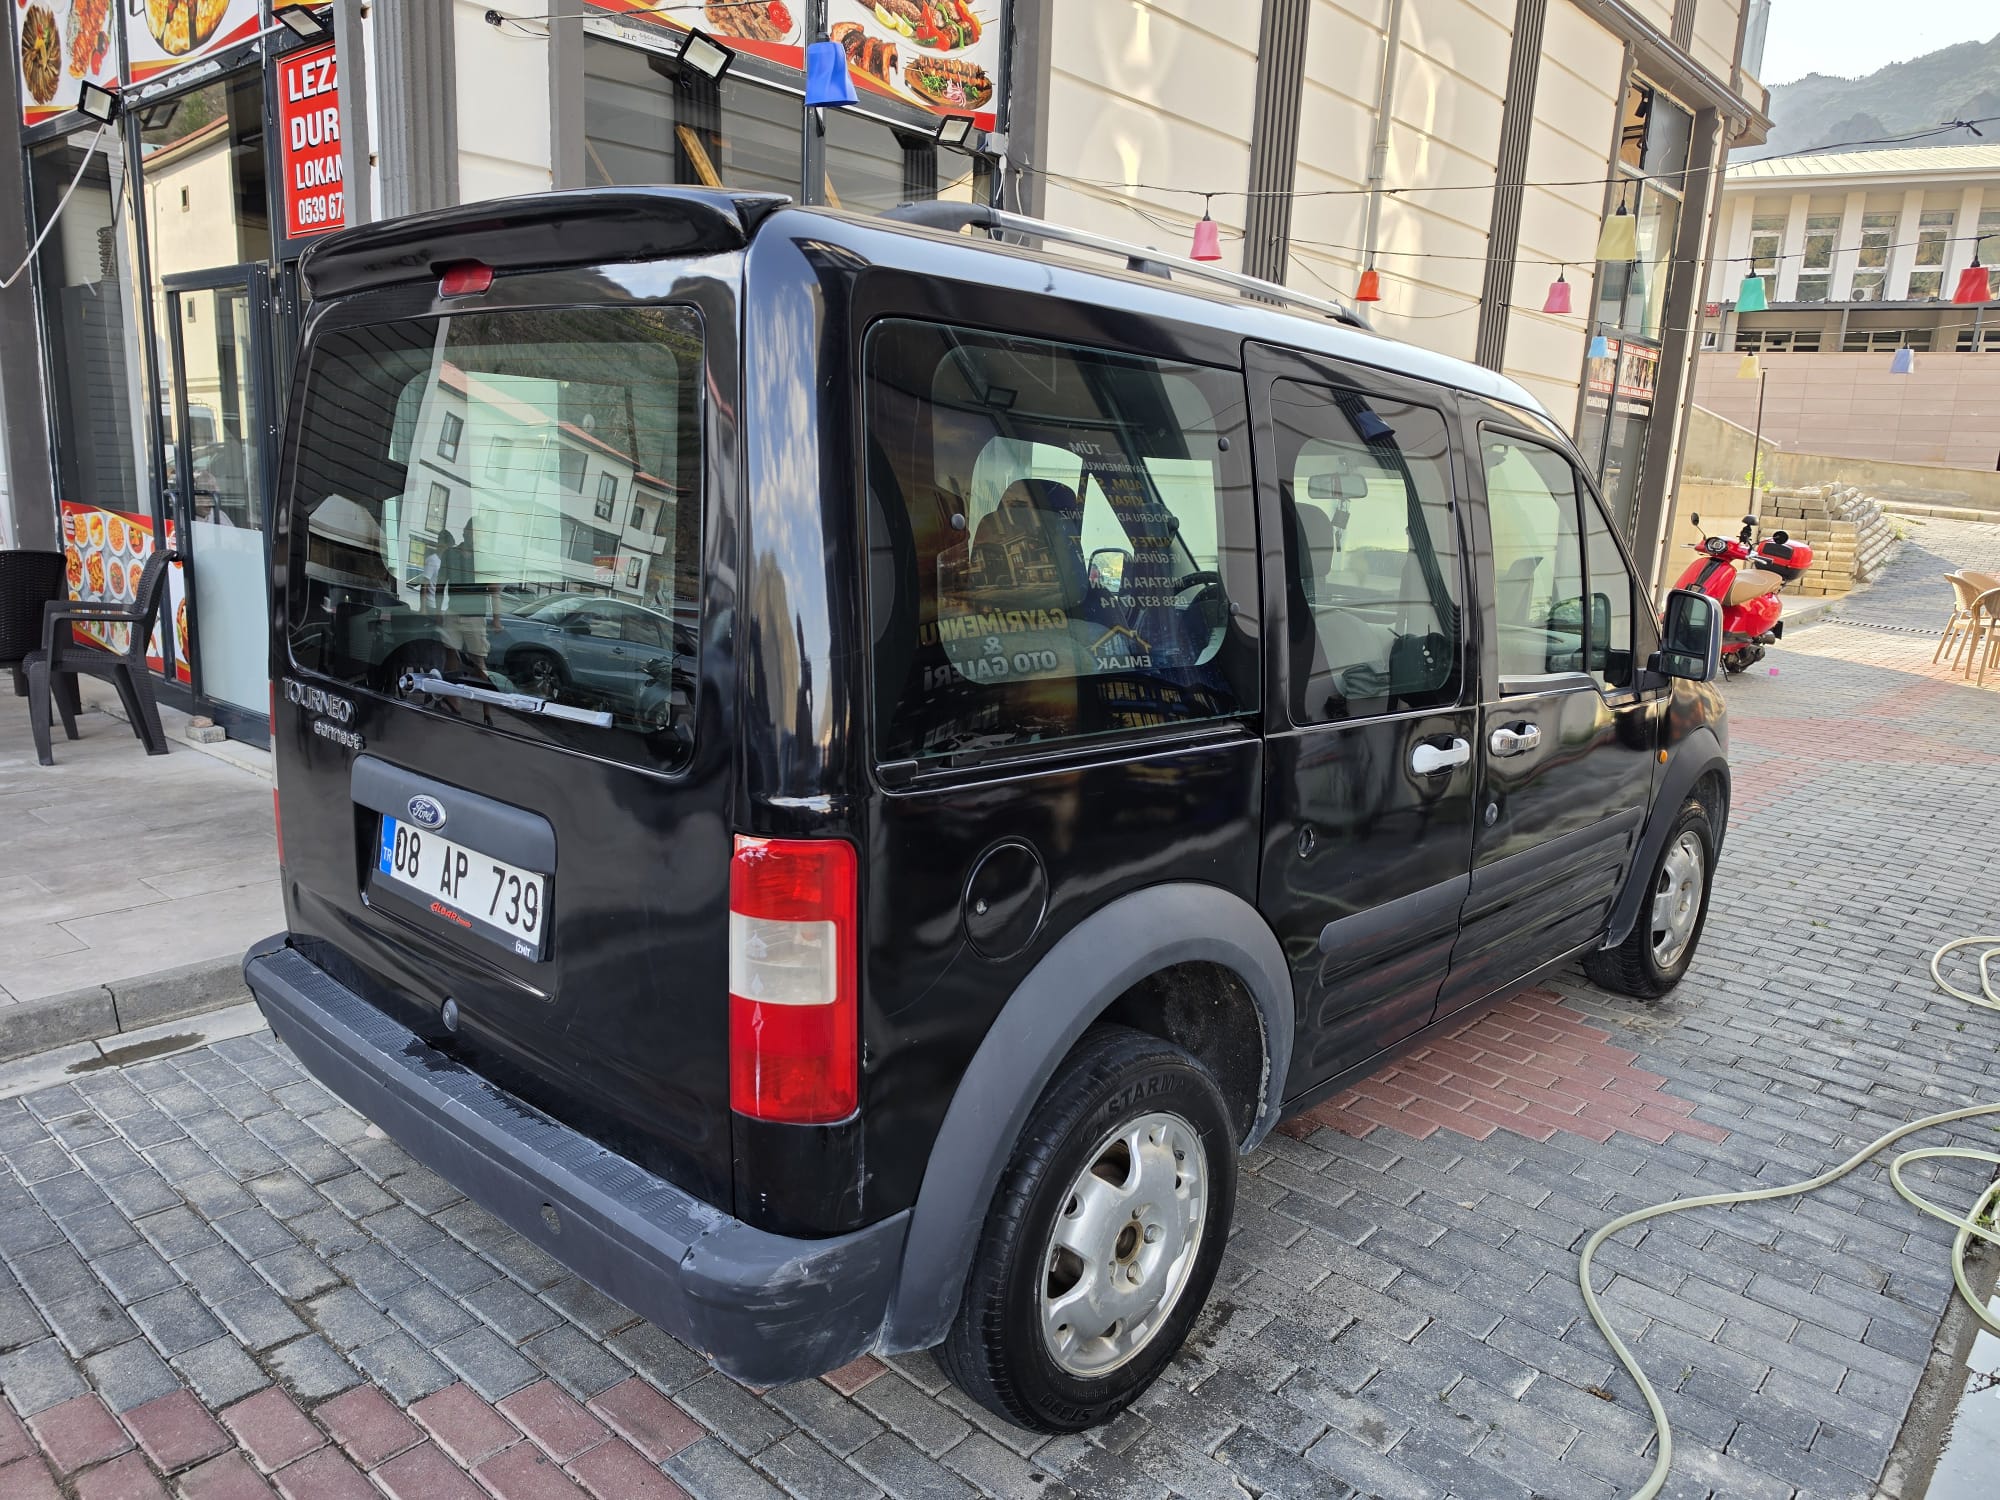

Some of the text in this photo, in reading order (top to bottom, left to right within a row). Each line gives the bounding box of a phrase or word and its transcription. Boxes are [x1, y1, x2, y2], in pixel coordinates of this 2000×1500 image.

[298, 191, 344, 225] 0539 67
[281, 677, 352, 723] TOURNEO
[313, 719, 364, 750] connect
[410, 800, 435, 823] Ford
[383, 846, 393, 864] TR
[394, 826, 539, 933] 08 AP 739
